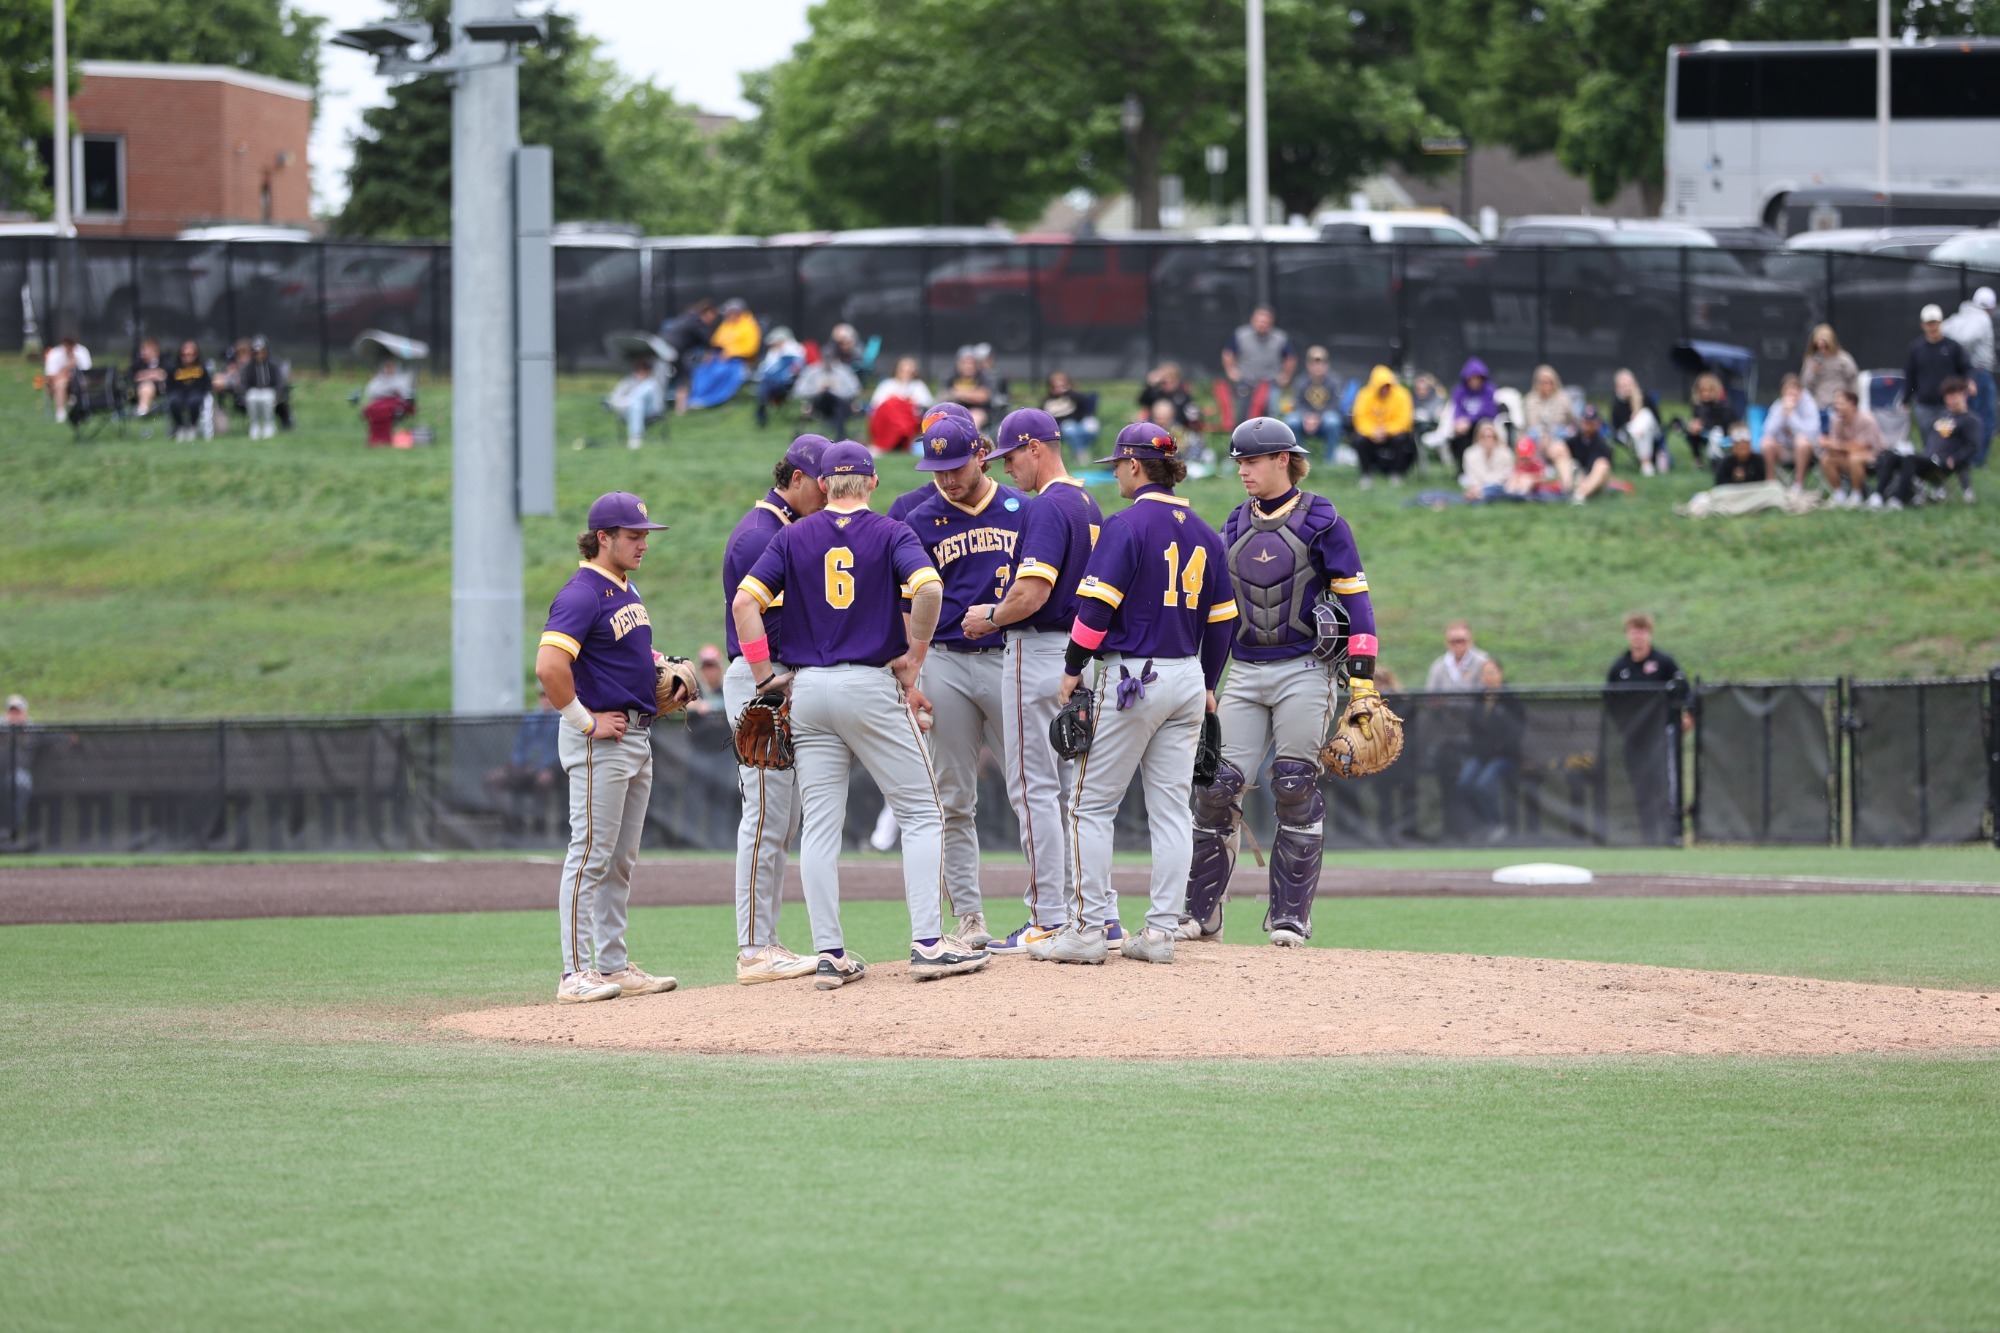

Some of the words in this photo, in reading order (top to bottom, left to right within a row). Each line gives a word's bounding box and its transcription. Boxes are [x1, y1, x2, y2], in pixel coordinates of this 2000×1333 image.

[932, 532, 968, 571] WEST
[1163, 541, 1208, 610] 14
[824, 546, 855, 610] 6
[609, 604, 637, 642] WEST
